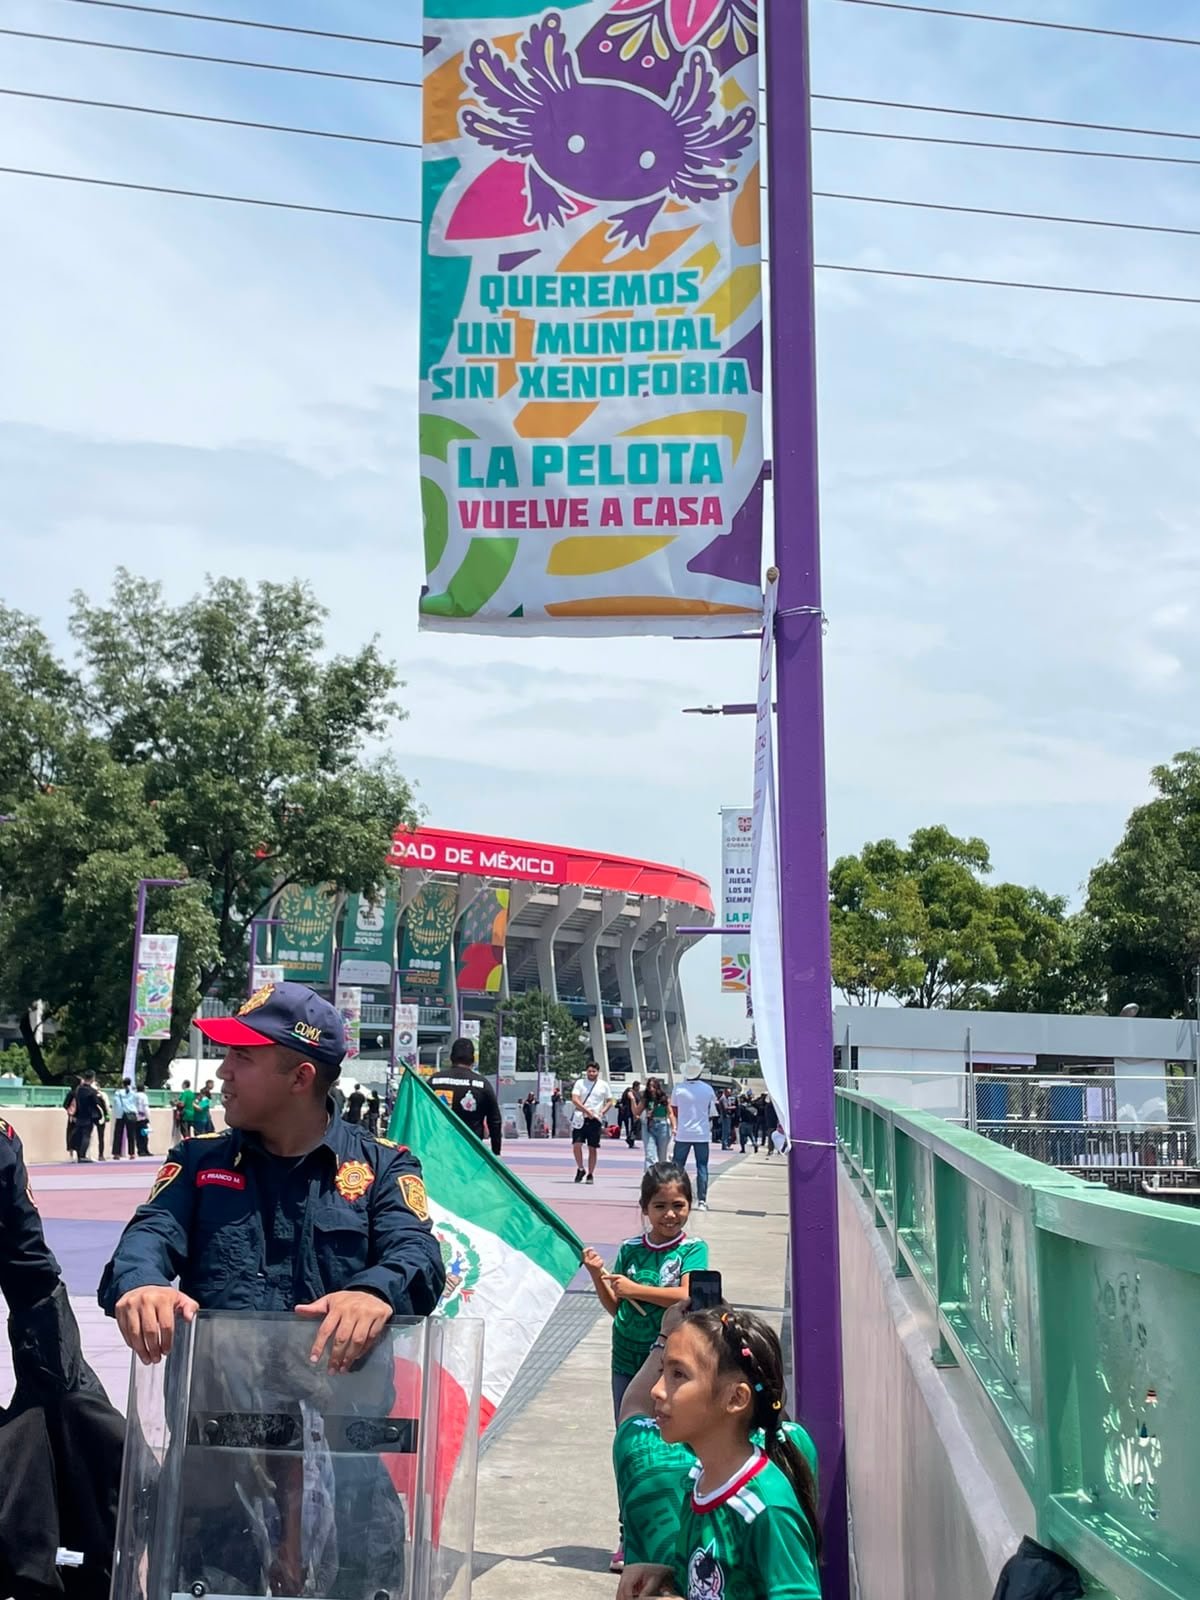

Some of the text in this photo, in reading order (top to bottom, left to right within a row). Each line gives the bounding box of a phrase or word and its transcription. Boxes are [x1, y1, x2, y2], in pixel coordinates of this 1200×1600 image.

[479, 270, 699, 313] QUEREMOS
[458, 317, 721, 355] UN MUNDIAL
[432, 361, 749, 400] SIN XENOFOBIA
[458, 443, 723, 488] LA PELOTA
[458, 496, 723, 529] VUELVE A CASA
[391, 841, 554, 875] DAD DE MÉXICO
[726, 913, 751, 922] LA P
[278, 950, 324, 962] WE ARE
[354, 937, 383, 945] 2026
[295, 1021, 322, 1042] CDMX
